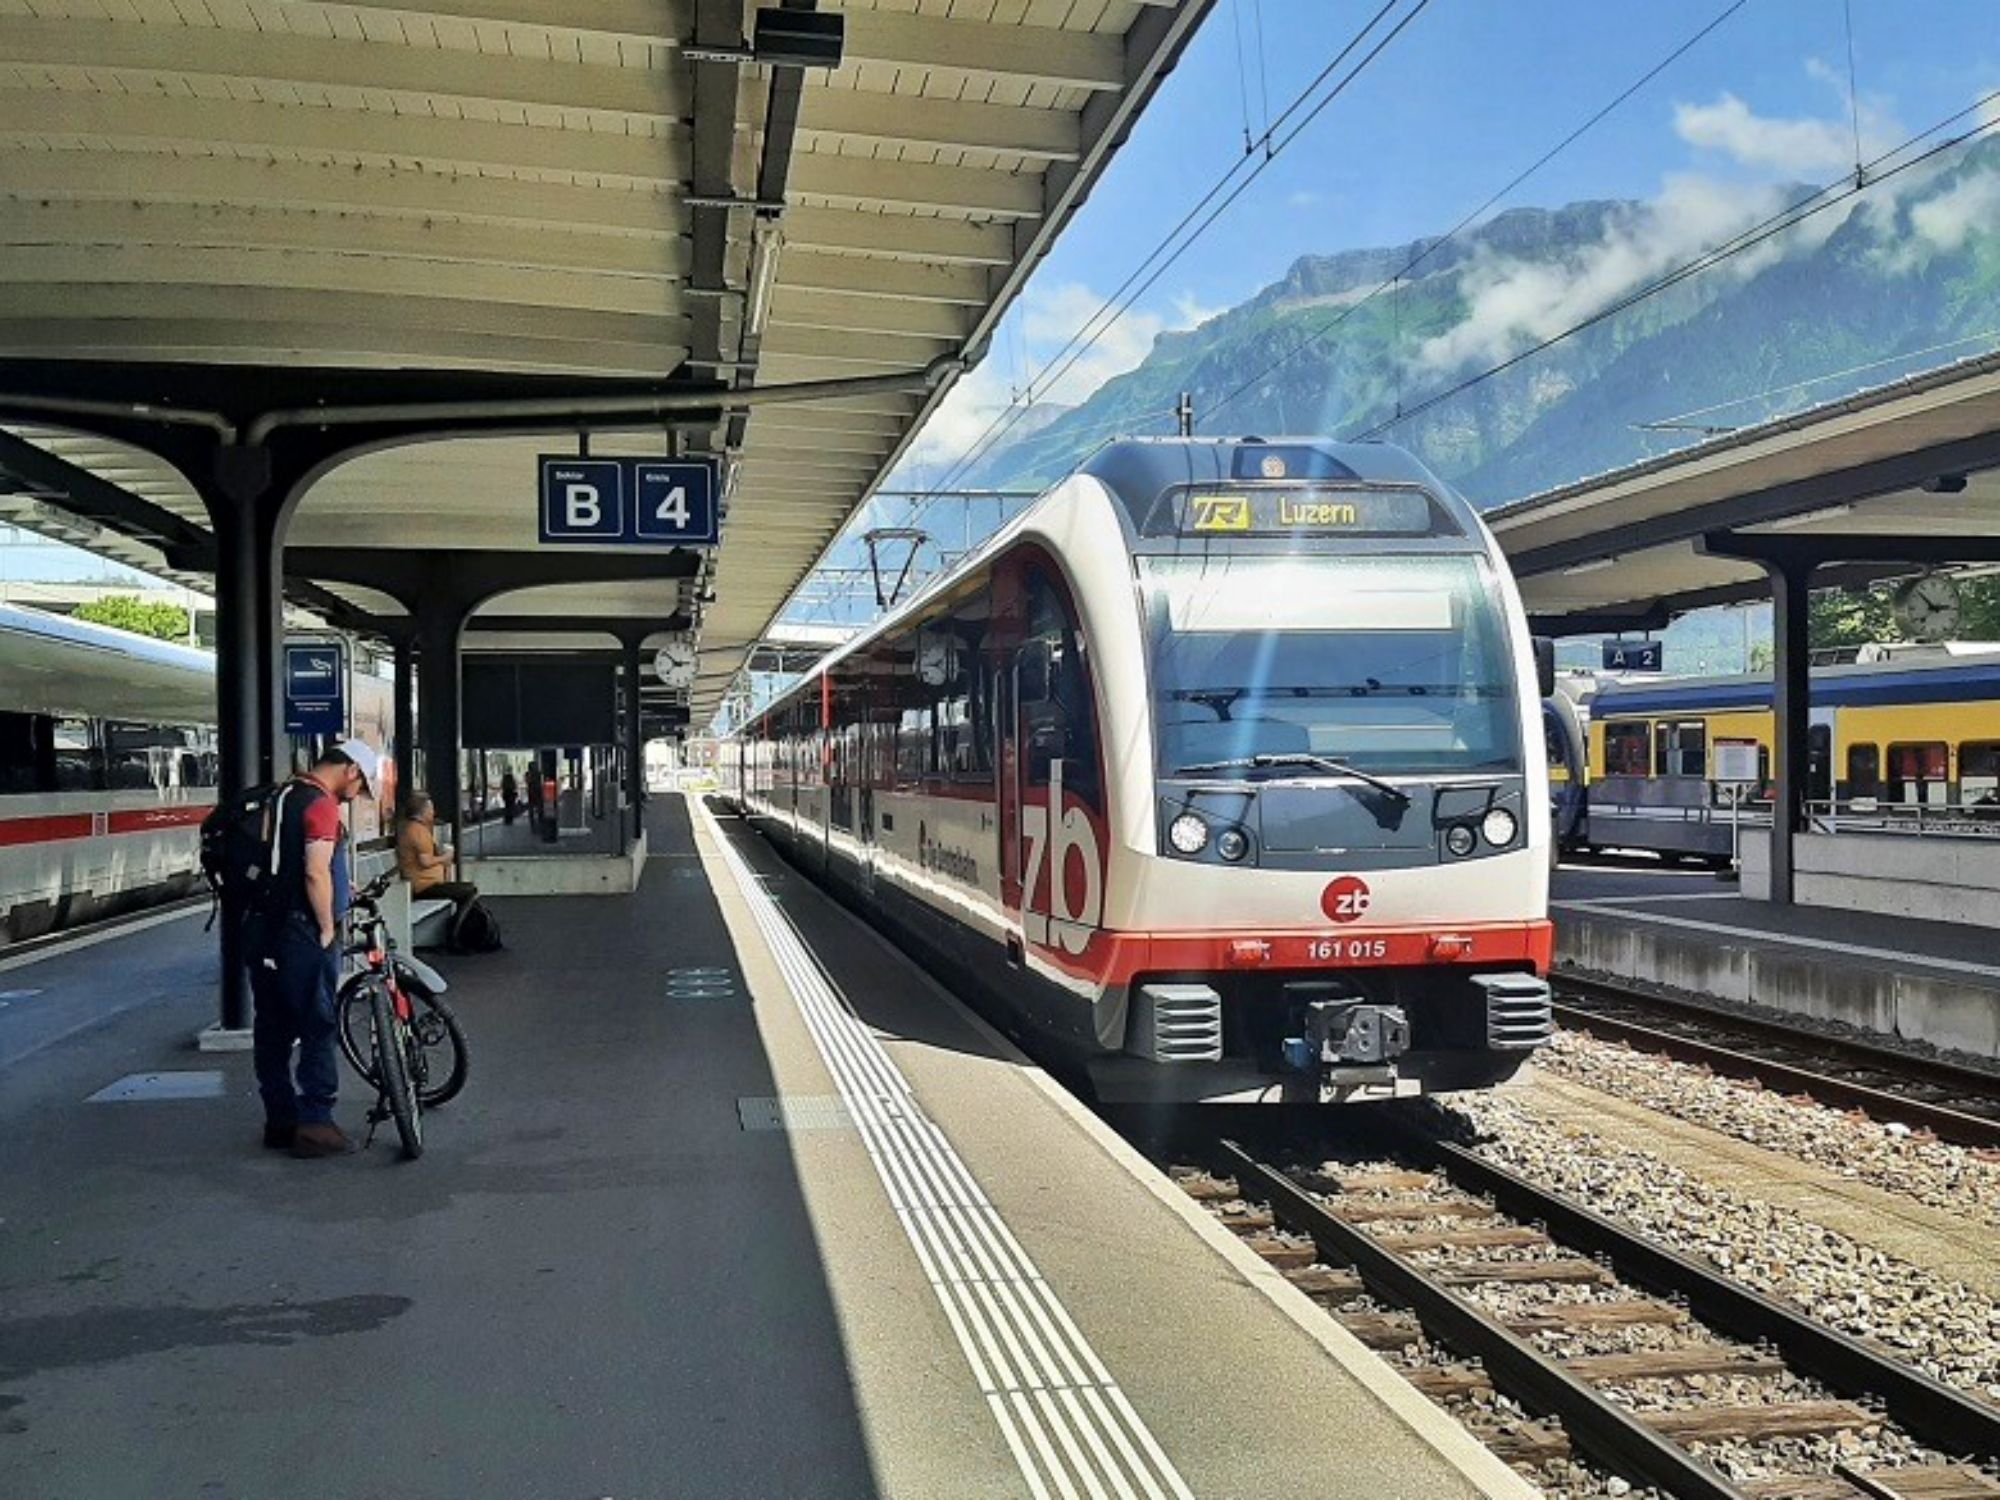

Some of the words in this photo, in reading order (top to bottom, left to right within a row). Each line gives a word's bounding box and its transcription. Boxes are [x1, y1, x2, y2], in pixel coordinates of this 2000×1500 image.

[566, 484, 601, 527] B
[655, 486, 691, 529] 4
[1280, 497, 1355, 524] Luzern
[1612, 649, 1627, 665] A
[1642, 650, 1655, 666] 2
[1022, 758, 1102, 955] zb
[1335, 889, 1372, 914] zb
[1308, 942, 1342, 959] 161
[1349, 941, 1386, 958] 015
